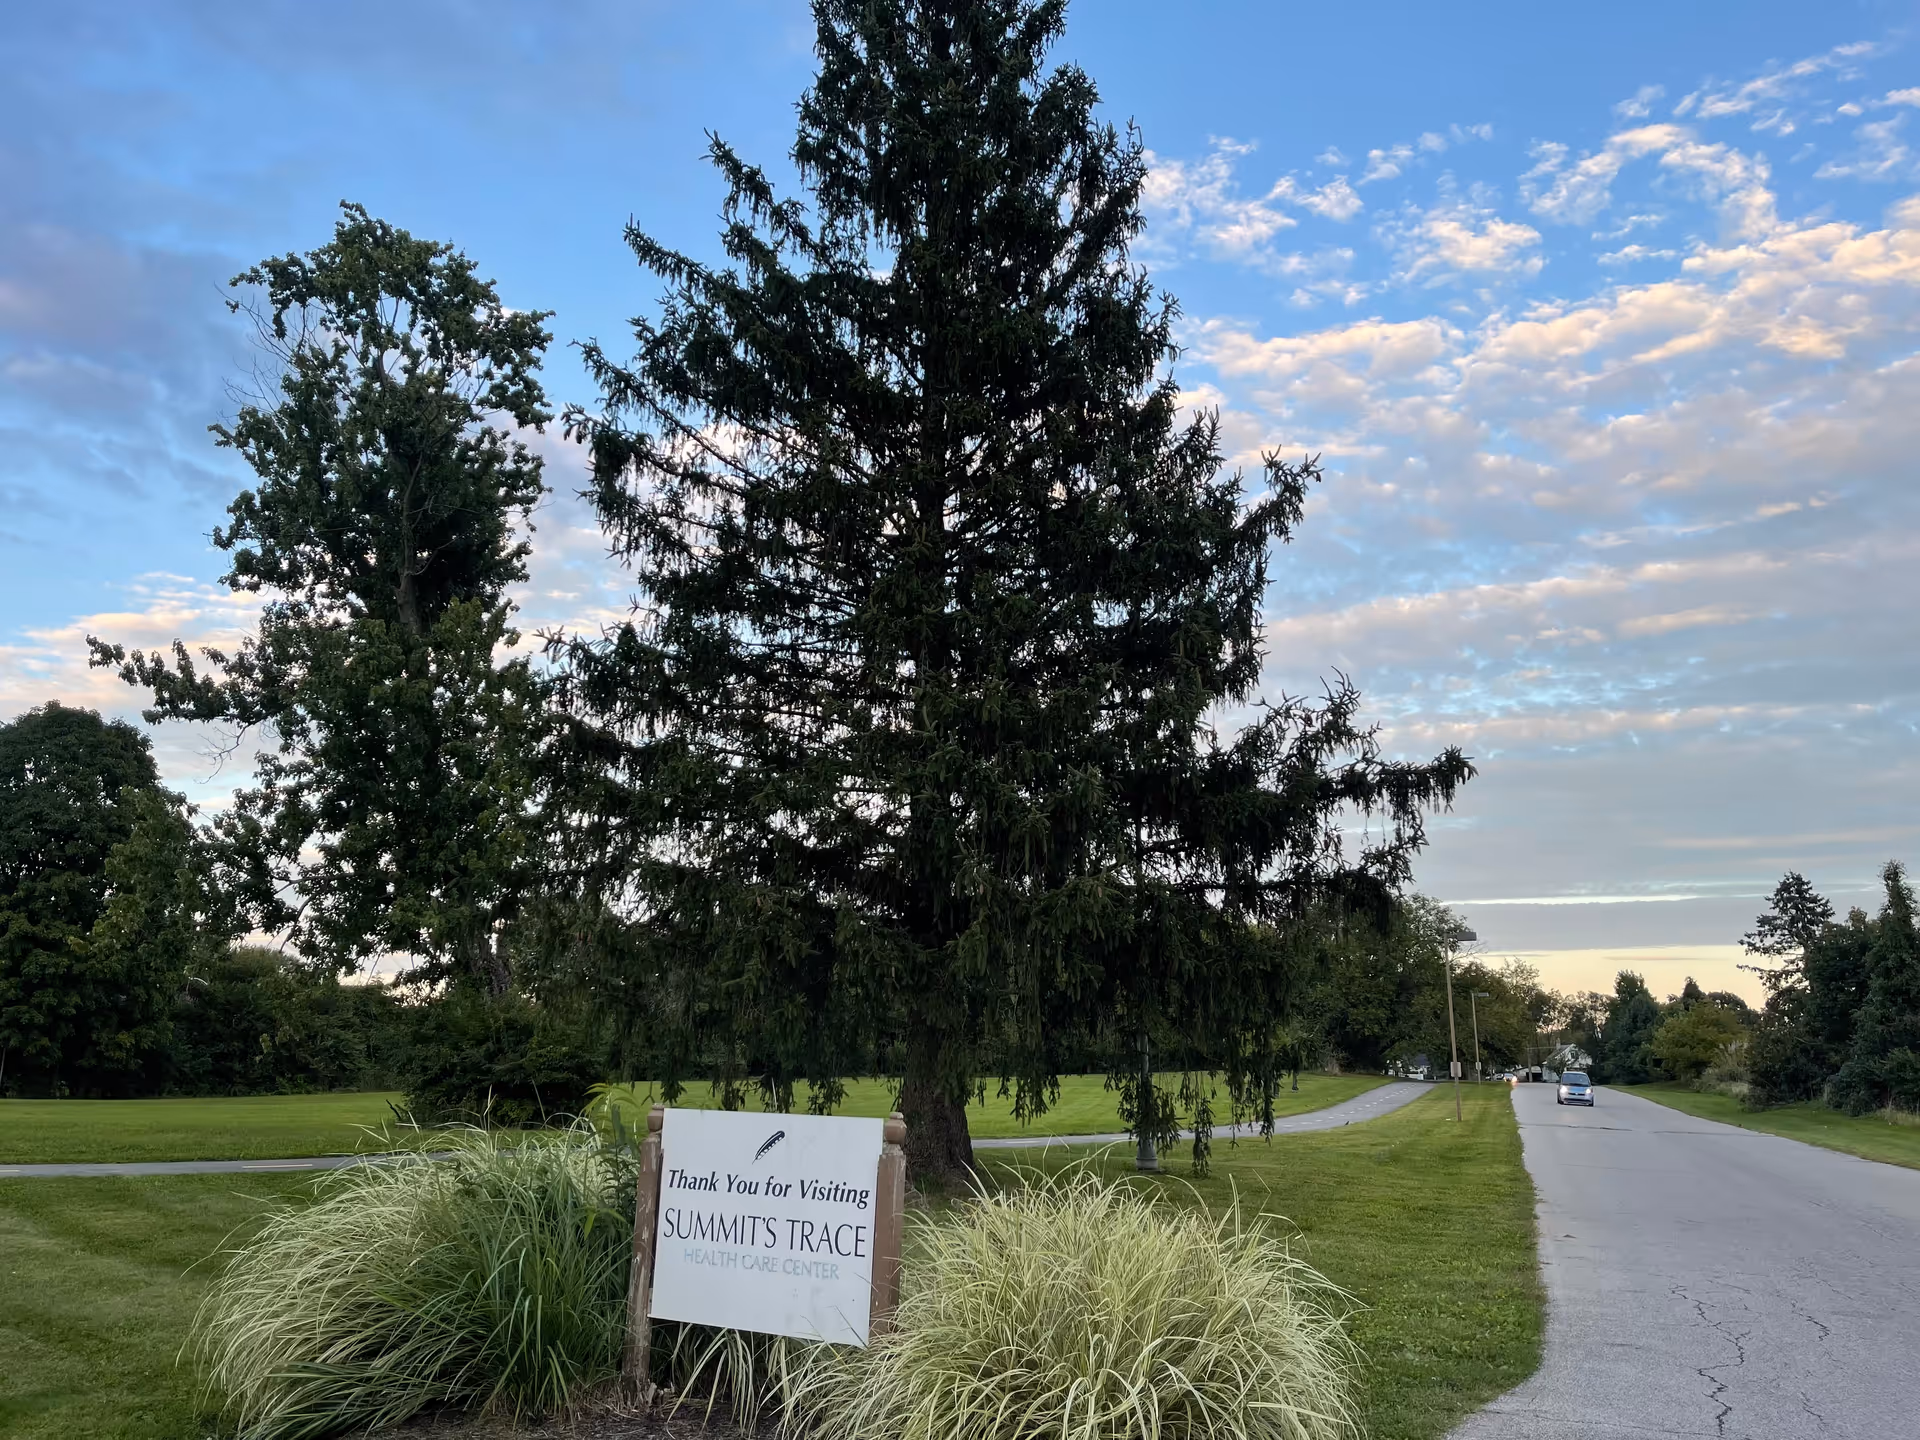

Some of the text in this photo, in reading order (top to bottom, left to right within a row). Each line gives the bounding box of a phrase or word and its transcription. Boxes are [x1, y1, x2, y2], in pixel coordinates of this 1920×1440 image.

[668, 1169, 870, 1209] Thank You for Visiting
[663, 1208, 867, 1258] SUMMIT'S TRACE
[684, 1248, 839, 1280] HEALTH CARE CENTER
